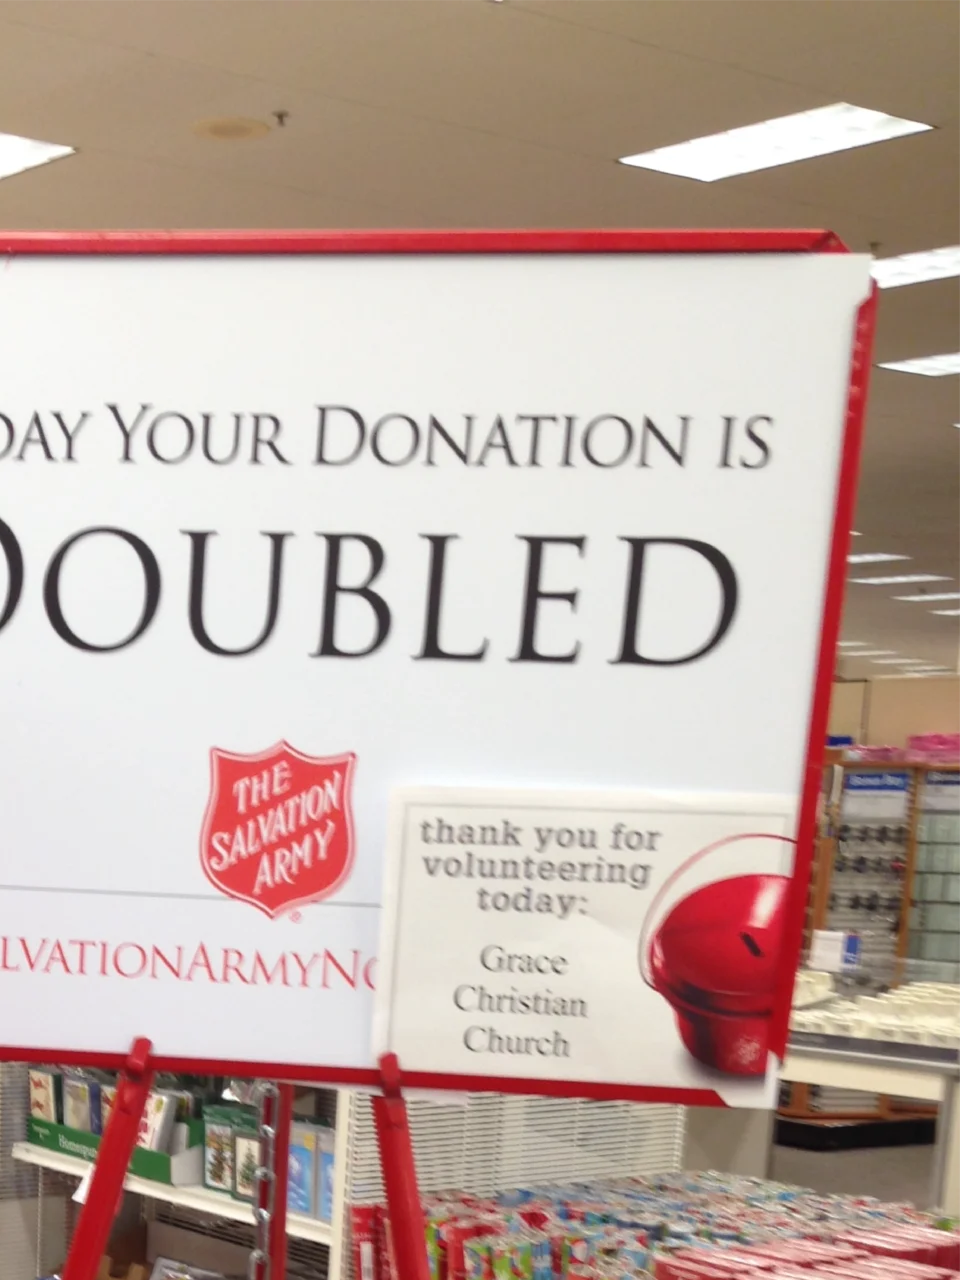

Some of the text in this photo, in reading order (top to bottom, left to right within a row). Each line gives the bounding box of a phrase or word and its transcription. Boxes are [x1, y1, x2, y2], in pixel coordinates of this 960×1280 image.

[103, 404, 292, 466] YOUR
[313, 405, 690, 470] DONATION
[718, 416, 773, 471] IS
[232, 759, 293, 815] THE
[209, 769, 342, 872] SALVATION
[419, 816, 663, 853] thank you for
[252, 818, 337, 896] ARMY
[421, 851, 653, 890] volunteering
[476, 886, 589, 920] today:
[479, 943, 570, 976] Grace
[452, 983, 589, 1019] Christian
[462, 1024, 571, 1058] Church
